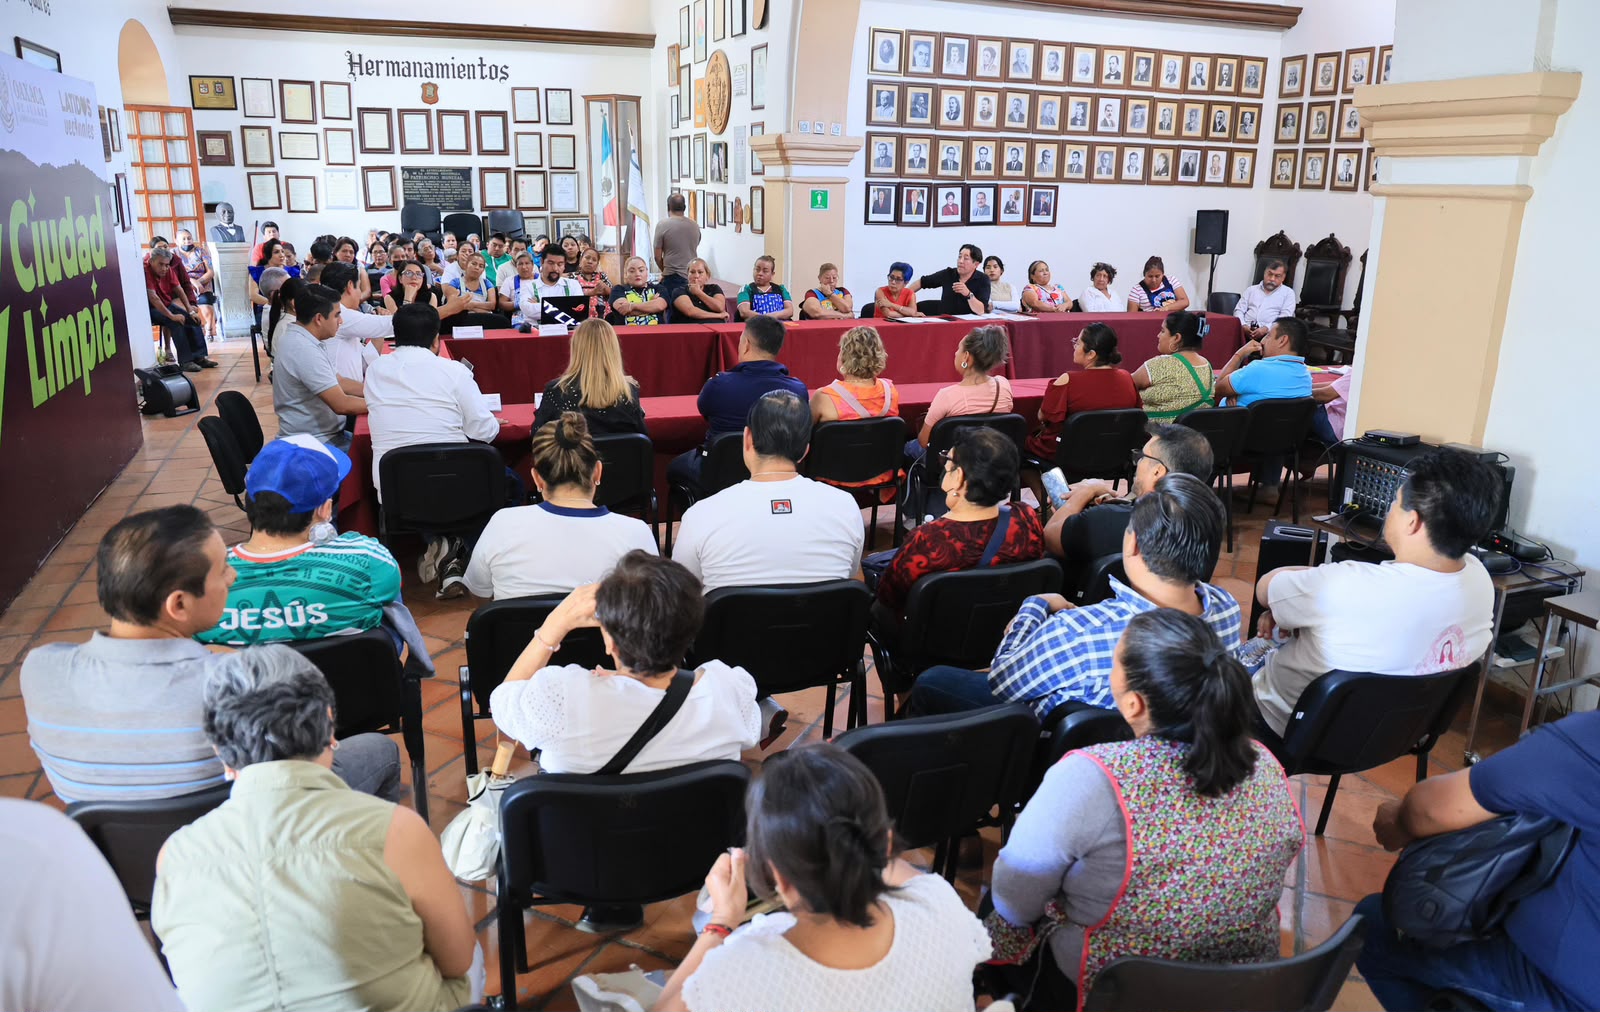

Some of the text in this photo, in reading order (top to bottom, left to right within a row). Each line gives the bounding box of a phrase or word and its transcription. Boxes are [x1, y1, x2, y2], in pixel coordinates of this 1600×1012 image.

[344, 50, 509, 84] Hermanamientos
[9, 187, 107, 293] Ciudad
[22, 274, 118, 409] Limpia
[219, 600, 329, 631] JESÚS
